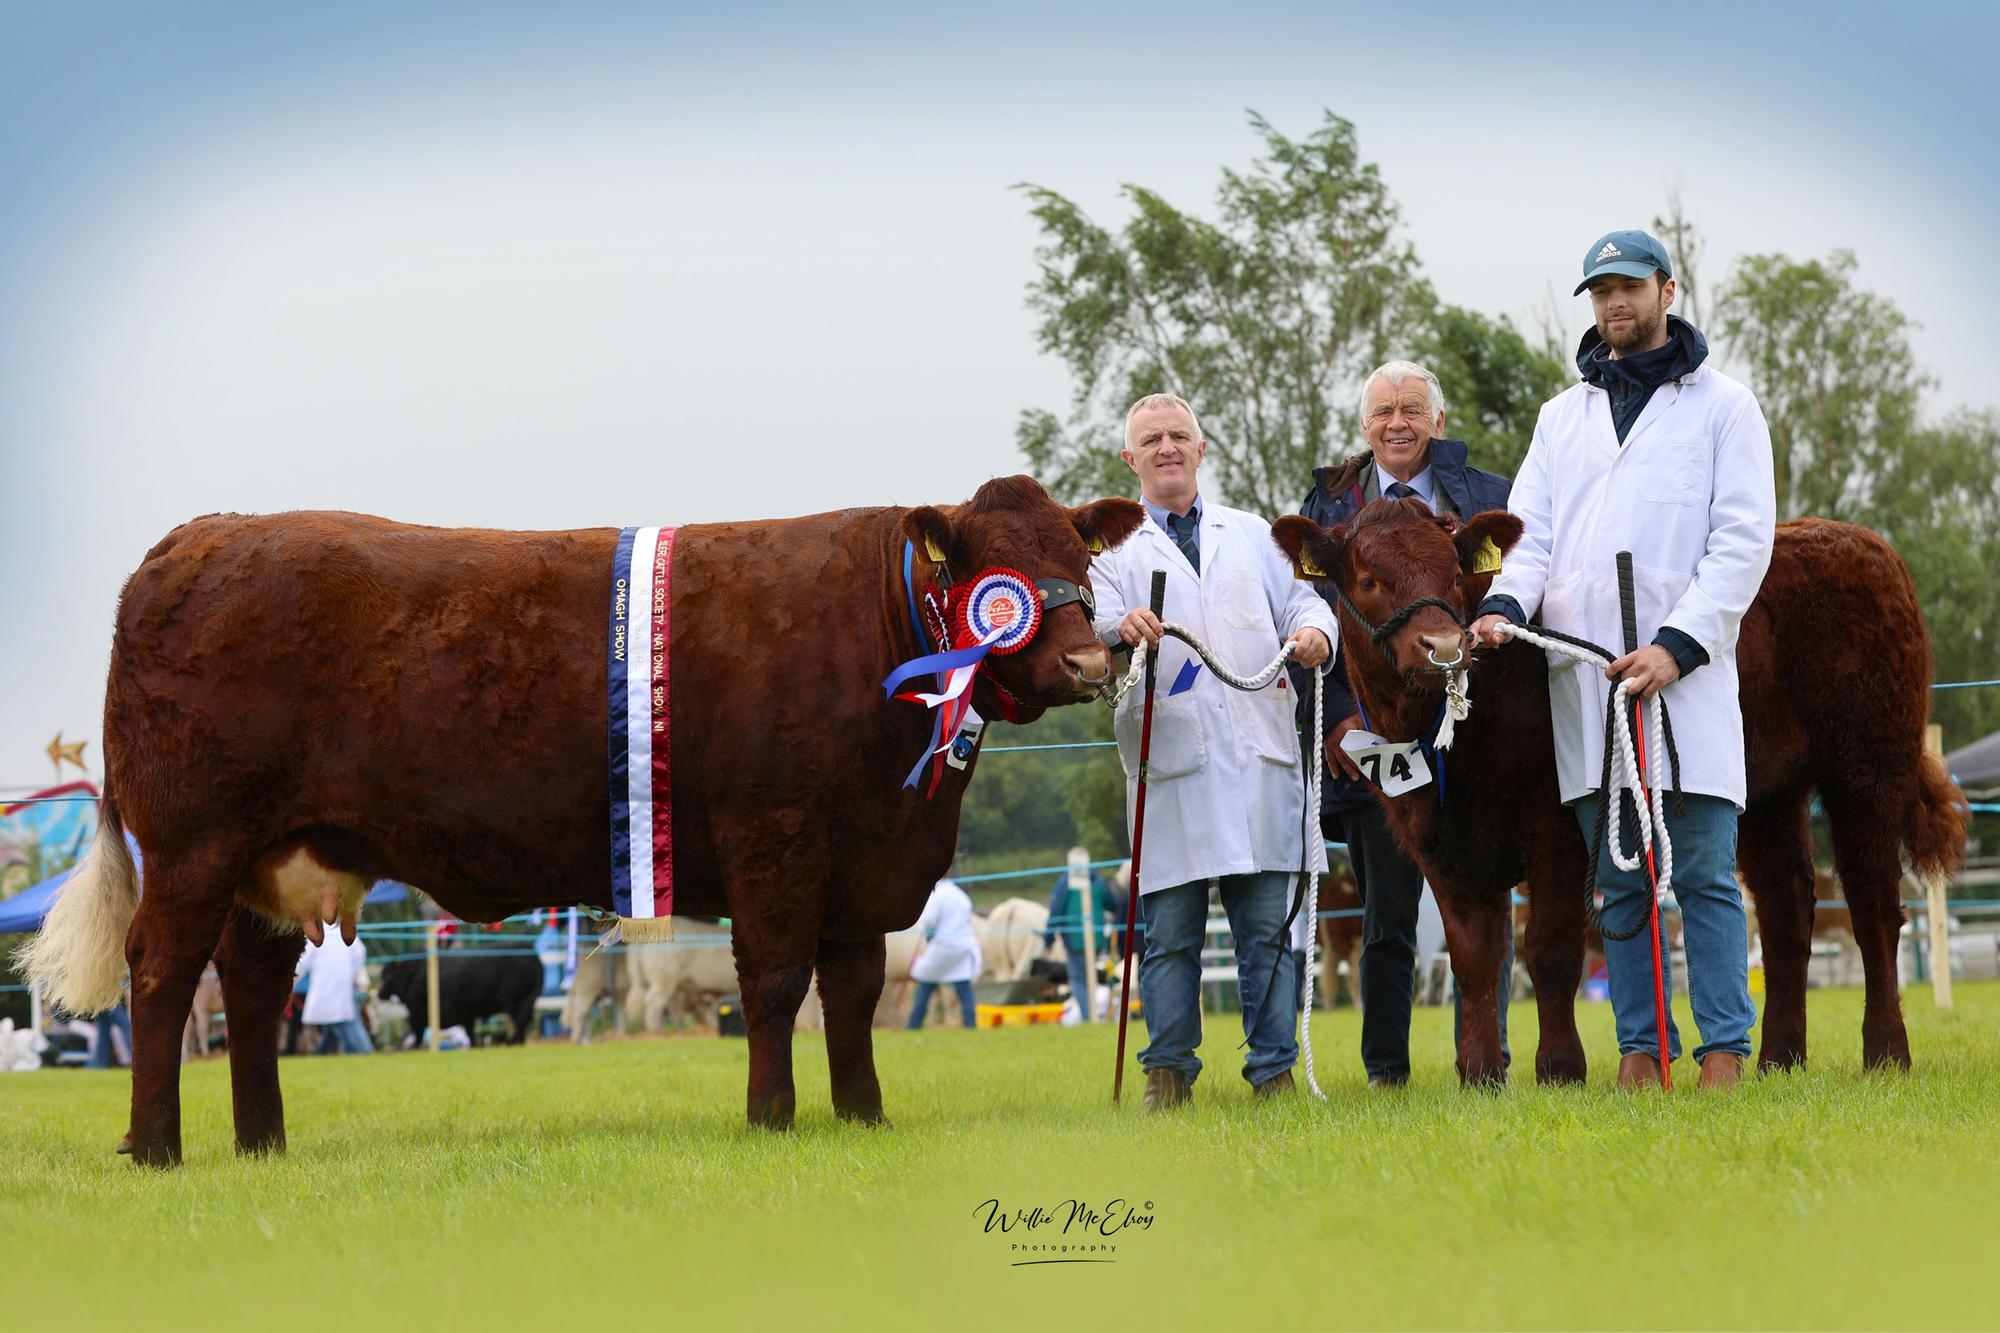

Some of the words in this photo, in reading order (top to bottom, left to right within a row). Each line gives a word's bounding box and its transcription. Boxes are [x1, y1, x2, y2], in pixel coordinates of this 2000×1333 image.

[1596, 250, 1622, 263] adidas
[655, 558, 666, 585] CATTLE
[615, 578, 626, 620] OMAGH
[654, 587, 665, 625] SOCIETY
[614, 625, 625, 661] SHOW
[653, 633, 664, 681] NATIONAL
[653, 686, 664, 717] SHOW
[653, 721, 664, 732] NI
[1361, 753, 1413, 790] 74
